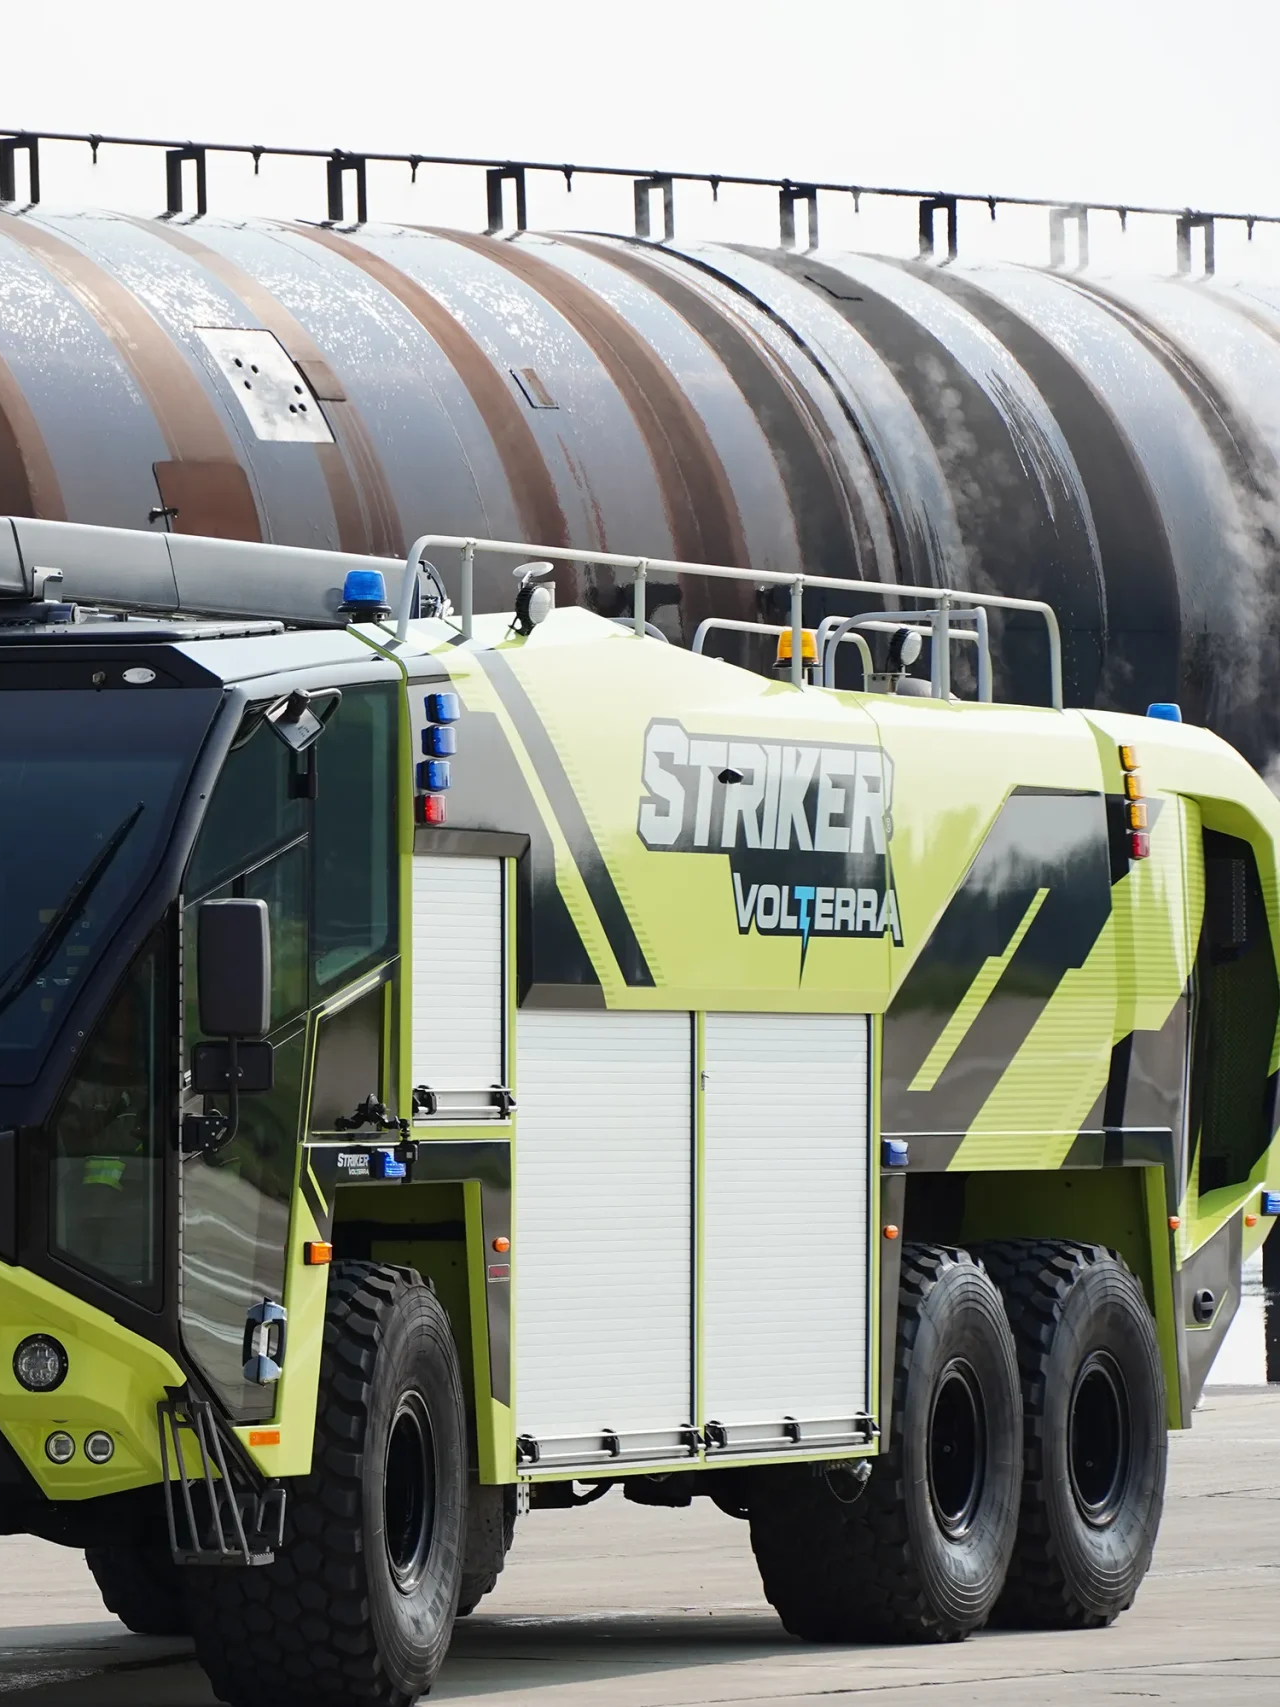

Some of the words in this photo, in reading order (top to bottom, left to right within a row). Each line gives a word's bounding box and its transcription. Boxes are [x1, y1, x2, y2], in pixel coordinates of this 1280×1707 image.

[639, 722, 893, 855] STRIKER
[733, 872, 902, 946] VOLTERRA
[337, 1153, 369, 1167] STRIKER
